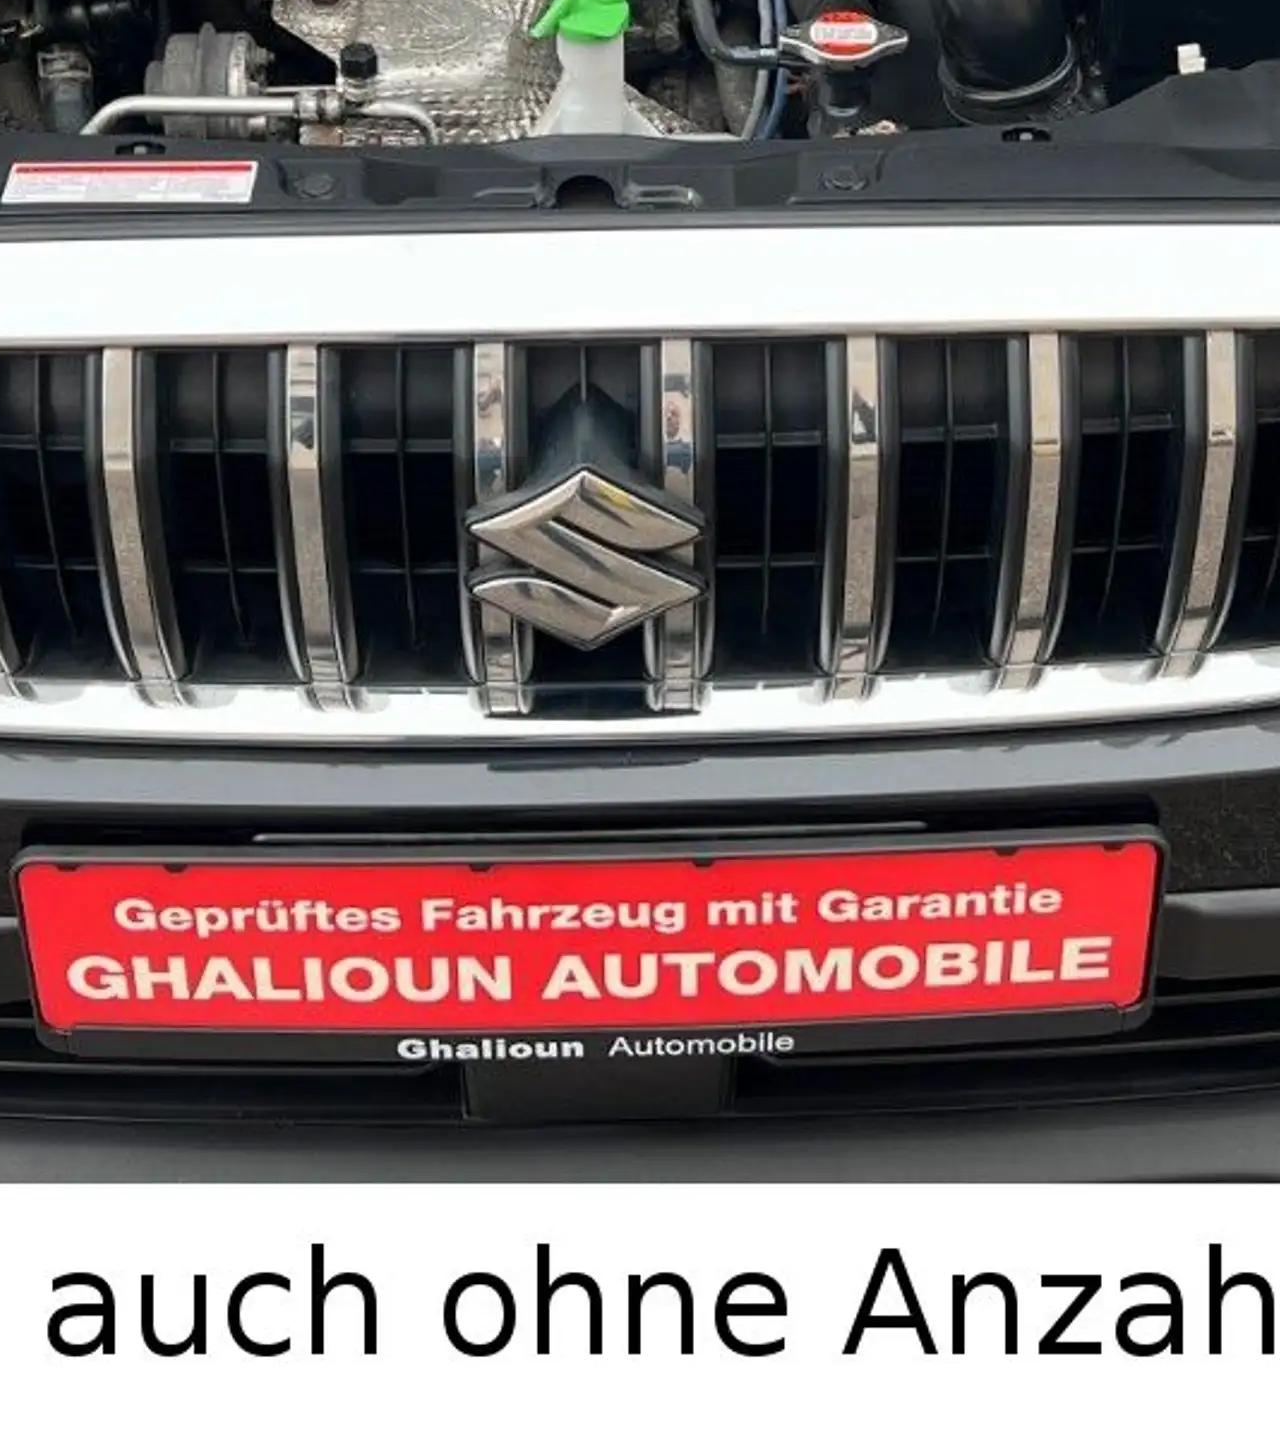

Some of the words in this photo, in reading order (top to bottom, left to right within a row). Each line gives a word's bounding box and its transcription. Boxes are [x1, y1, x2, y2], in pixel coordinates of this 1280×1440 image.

[114, 899, 401, 938] Geprüftes
[422, 898, 686, 934] Fahrzeug
[708, 893, 797, 925] mit
[818, 883, 1062, 922] Garantie
[67, 955, 512, 1002] GHALIOUN
[542, 936, 1113, 1000] AUTOMOBILE
[397, 1038, 584, 1060] Ghalioun
[608, 1031, 794, 1057] Automobile
